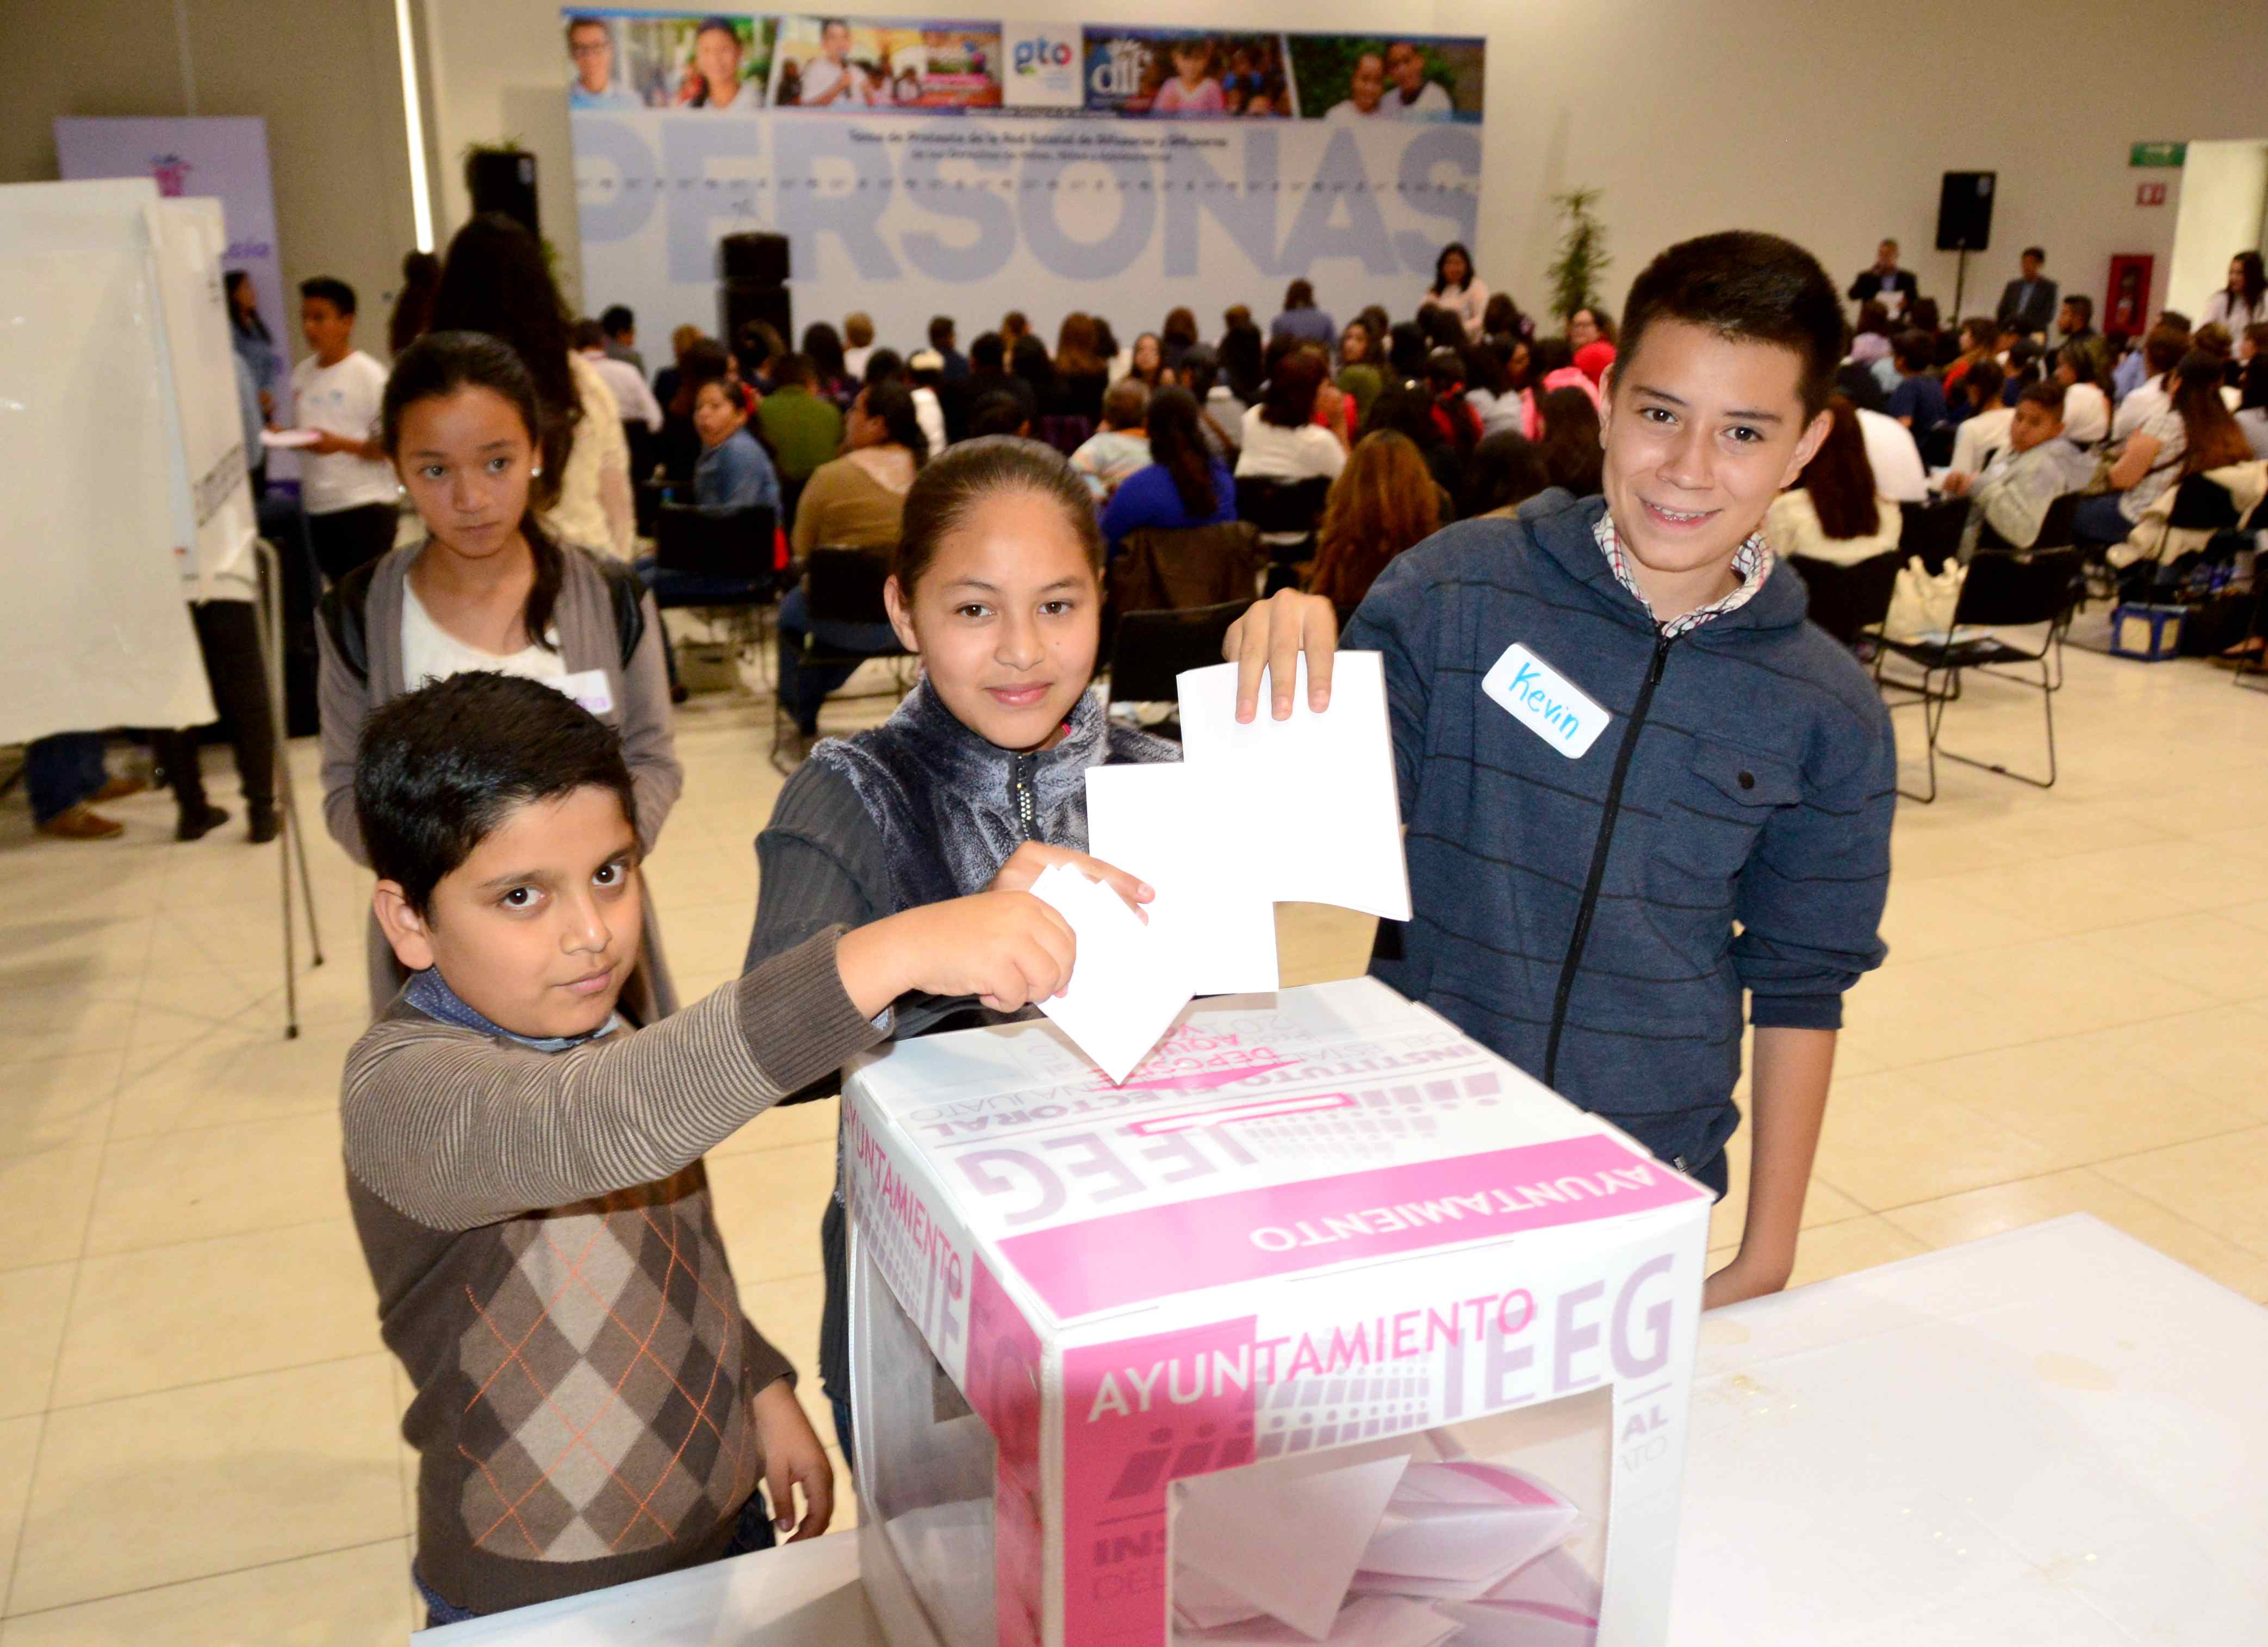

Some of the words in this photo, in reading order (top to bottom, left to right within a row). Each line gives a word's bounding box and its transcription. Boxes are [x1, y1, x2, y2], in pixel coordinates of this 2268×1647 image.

[1013, 35, 1073, 75] gto
[573, 119, 1481, 284] PERSONAS
[1508, 662, 1580, 741] Kevin
[1250, 1165, 1657, 1253] AYUNTAMIENTO
[1088, 1287, 1534, 1424] AYUNTAMIENTO
[1443, 1252, 1675, 1421] IEEG
